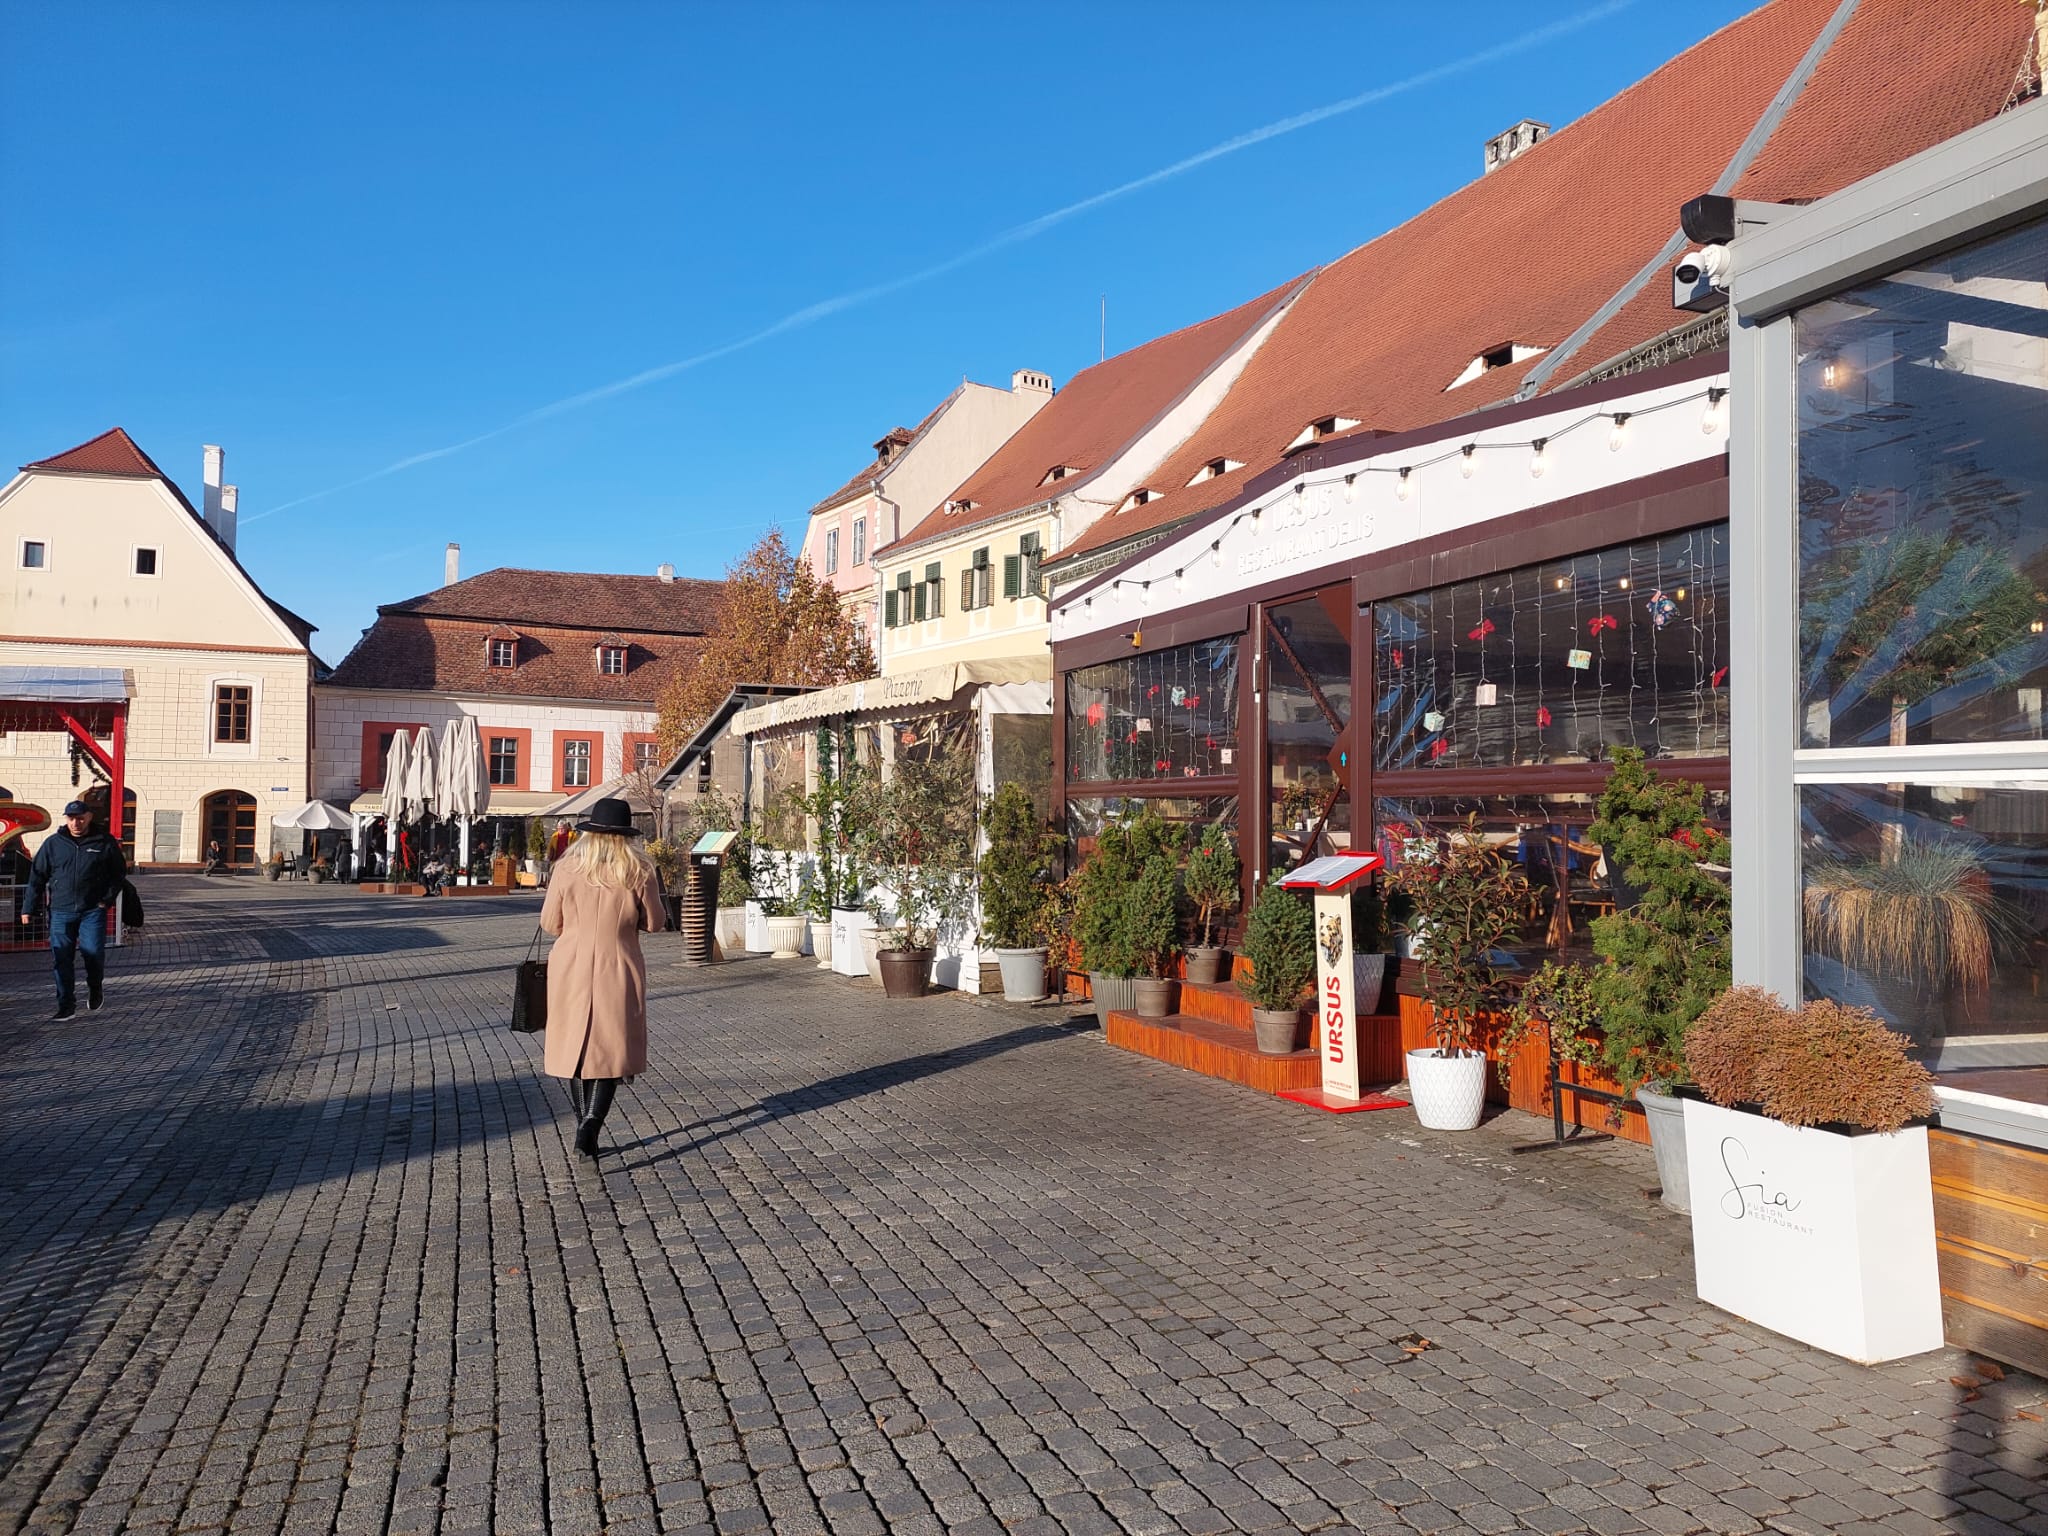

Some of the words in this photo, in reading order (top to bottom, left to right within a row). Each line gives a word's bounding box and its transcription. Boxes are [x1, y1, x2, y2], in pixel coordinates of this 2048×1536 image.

[881, 673, 923, 700] Pizzerie
[1325, 975, 1345, 1064] URSUS
[1720, 1136, 1802, 1220] Sia
[1747, 1201, 1783, 1219] FUSION
[1747, 1210, 1815, 1236] RESTAURANT
